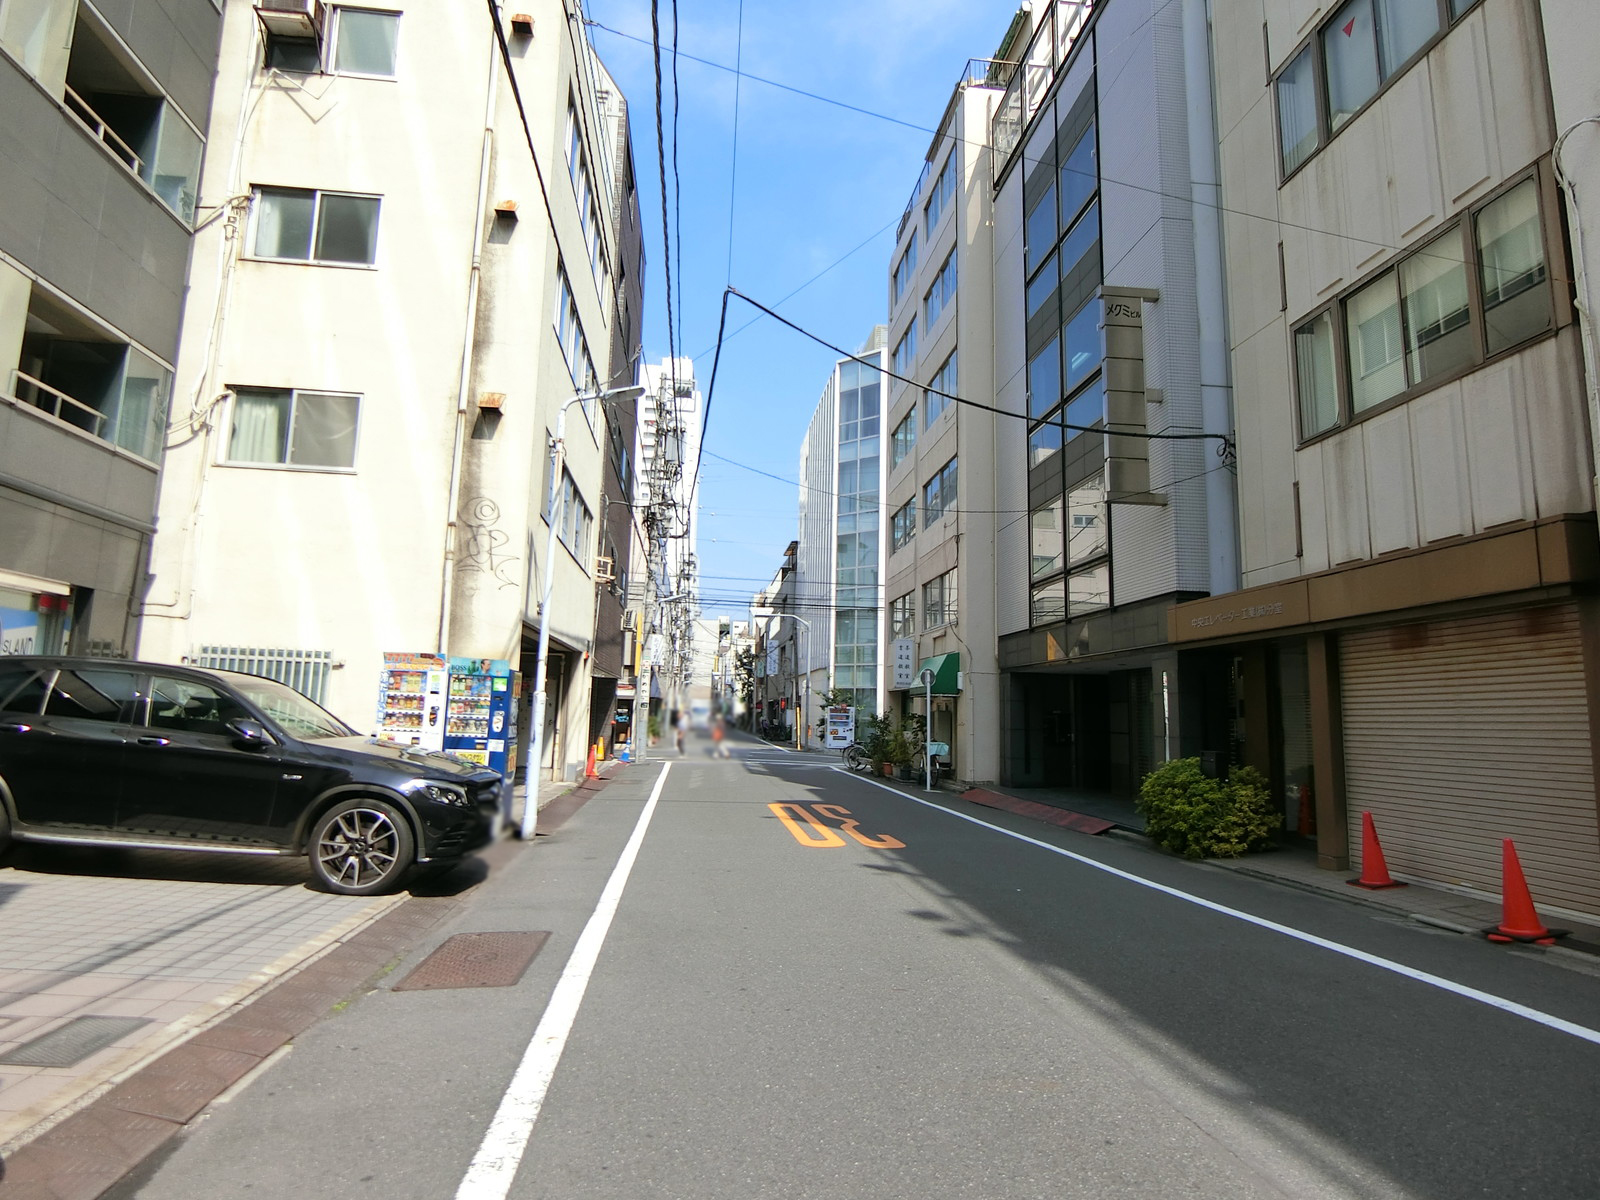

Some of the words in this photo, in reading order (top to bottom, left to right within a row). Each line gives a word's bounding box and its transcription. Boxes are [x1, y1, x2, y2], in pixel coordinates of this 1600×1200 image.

[1107, 304, 1141, 318] メグミビル
[451, 664, 467, 672] BOSS
[767, 803, 906, 848] 30
